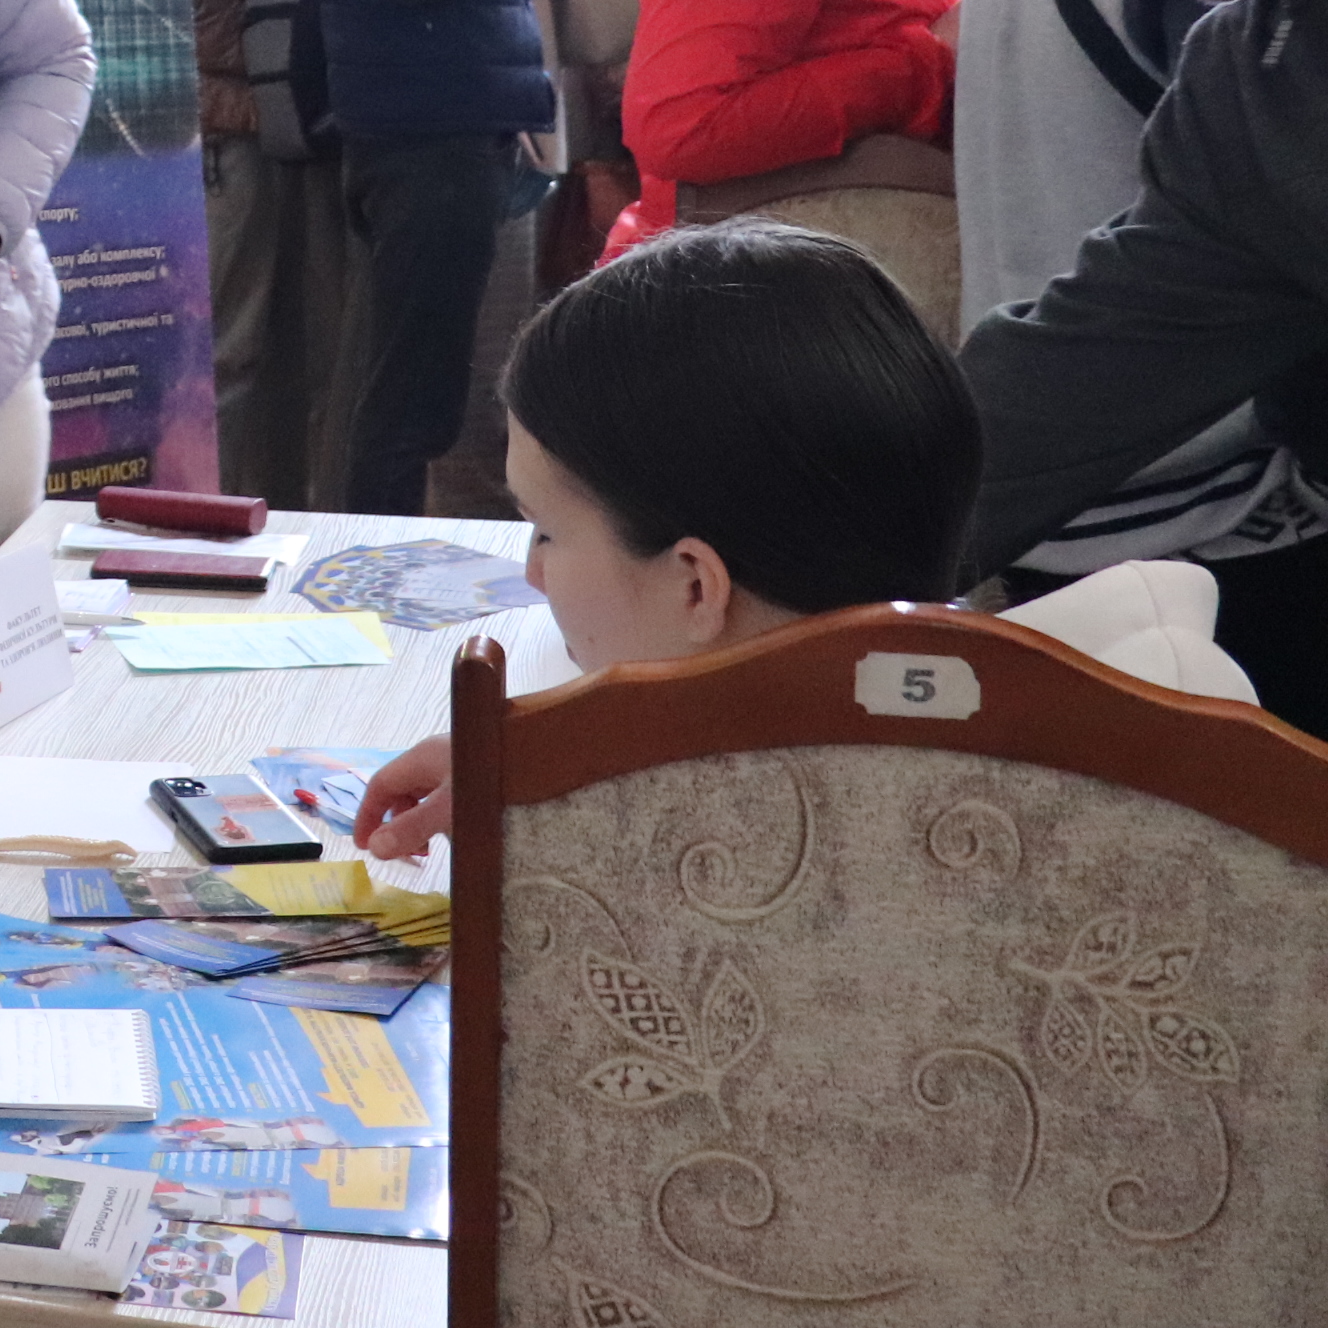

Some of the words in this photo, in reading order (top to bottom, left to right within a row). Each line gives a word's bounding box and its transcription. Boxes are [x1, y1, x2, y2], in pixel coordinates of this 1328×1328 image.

[77, 249, 98, 265] або
[47, 472, 66, 494] Ш
[71, 456, 147, 490] ВЧИТИСЯ?
[901, 669, 936, 702] 5
[84, 1185, 119, 1249] Запрошуємо!
